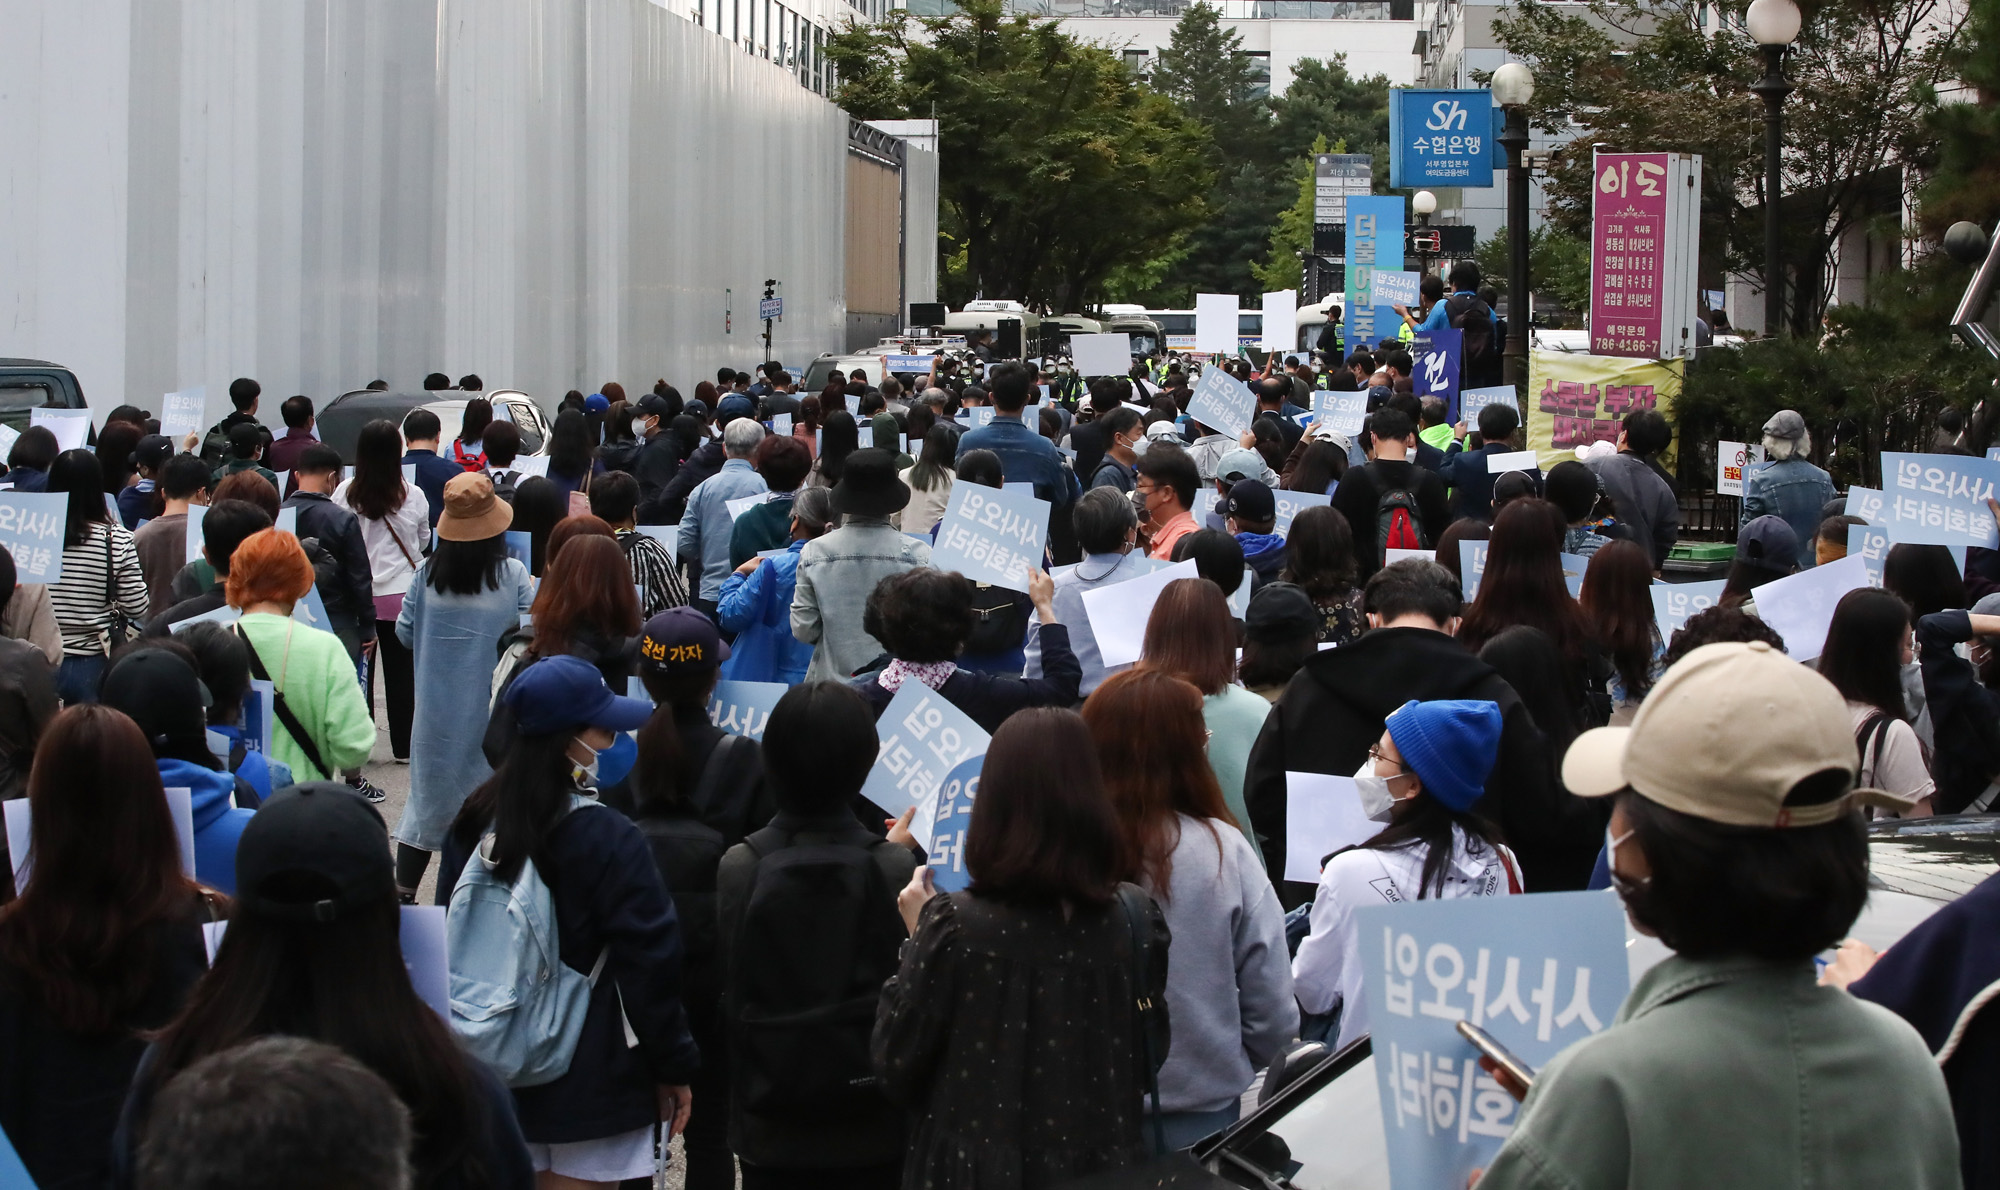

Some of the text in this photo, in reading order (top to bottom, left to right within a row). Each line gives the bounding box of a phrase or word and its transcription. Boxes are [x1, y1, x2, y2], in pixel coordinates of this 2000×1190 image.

[1425, 100, 1467, 130] Sh
[1413, 135, 1481, 155] 수협은행
[1425, 160, 1469, 168] 서부영업본부
[1425, 169, 1469, 177] 여의도금융센터
[1599, 160, 1665, 198] 이도
[1608, 225, 1623, 234] 고기류
[1634, 225, 1651, 234] 식사류
[1606, 238, 1624, 251] 생등심
[1605, 256, 1624, 270] 안창살
[1604, 274, 1623, 288] 갈비살
[1604, 292, 1623, 306] 삼겹살
[1606, 325, 1646, 337] 예약문의
[1424, 350, 1449, 393] 전
[1540, 378, 1657, 420] 소문난 부자
[1725, 466, 1741, 480] 금연
[670, 644, 703, 662] 가자
